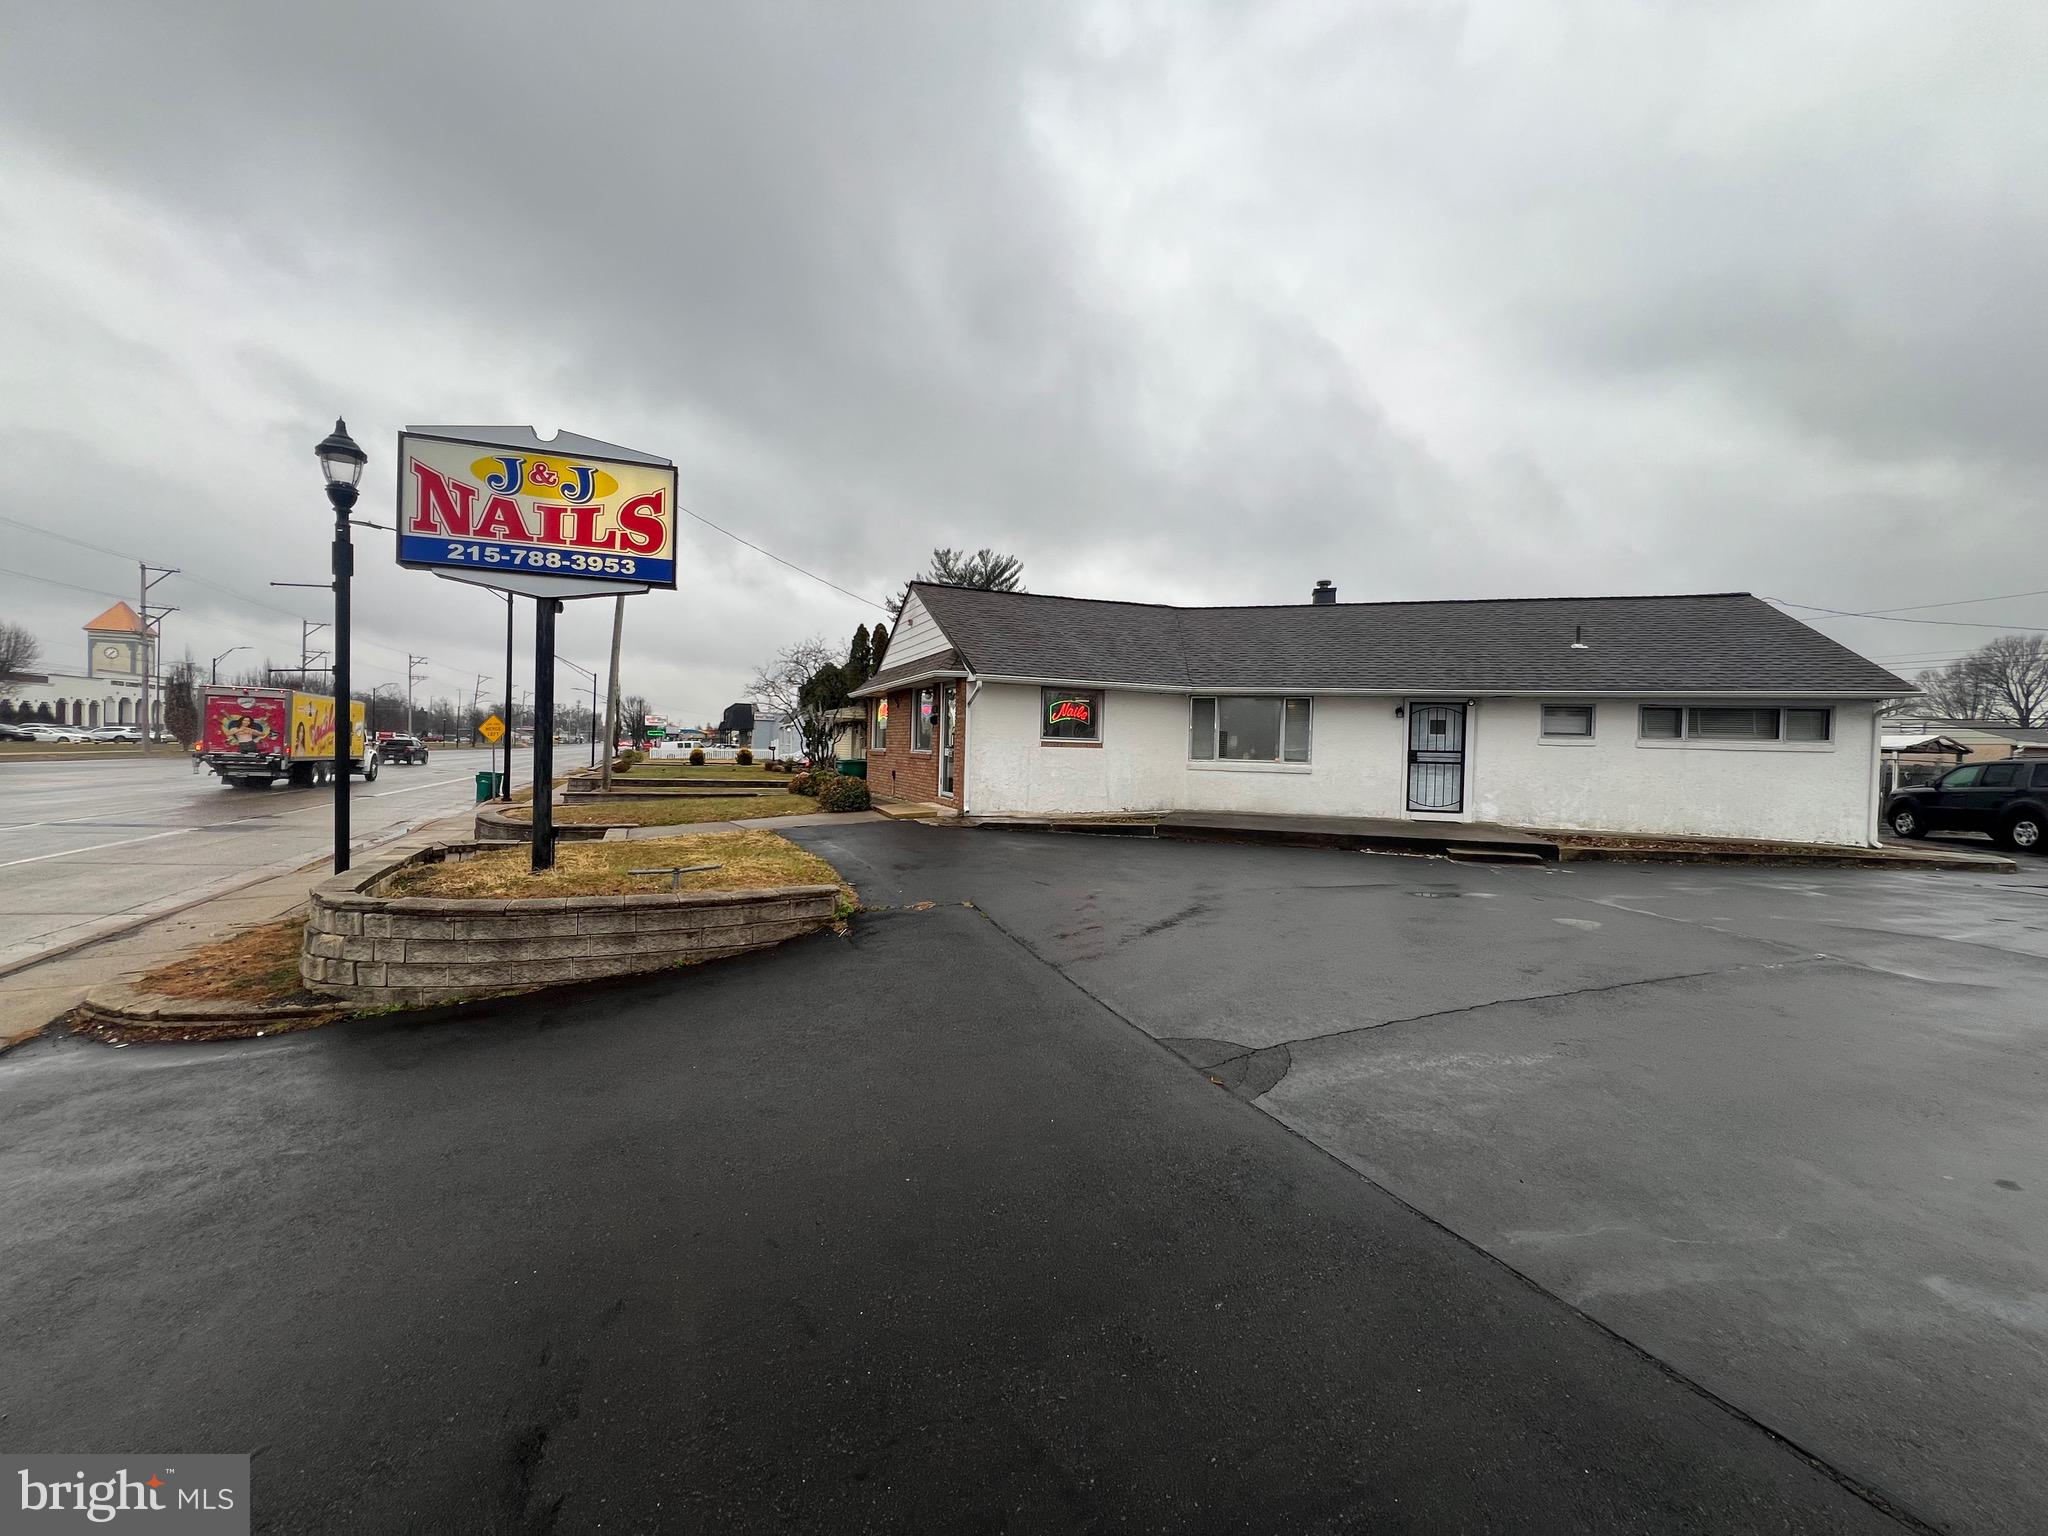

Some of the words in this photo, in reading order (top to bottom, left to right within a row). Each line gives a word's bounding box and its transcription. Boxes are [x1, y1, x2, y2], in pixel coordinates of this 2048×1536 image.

[409, 456, 667, 555] NAILS
[447, 543, 636, 575] 215-788-3953
[1052, 703, 1087, 720] Nails
